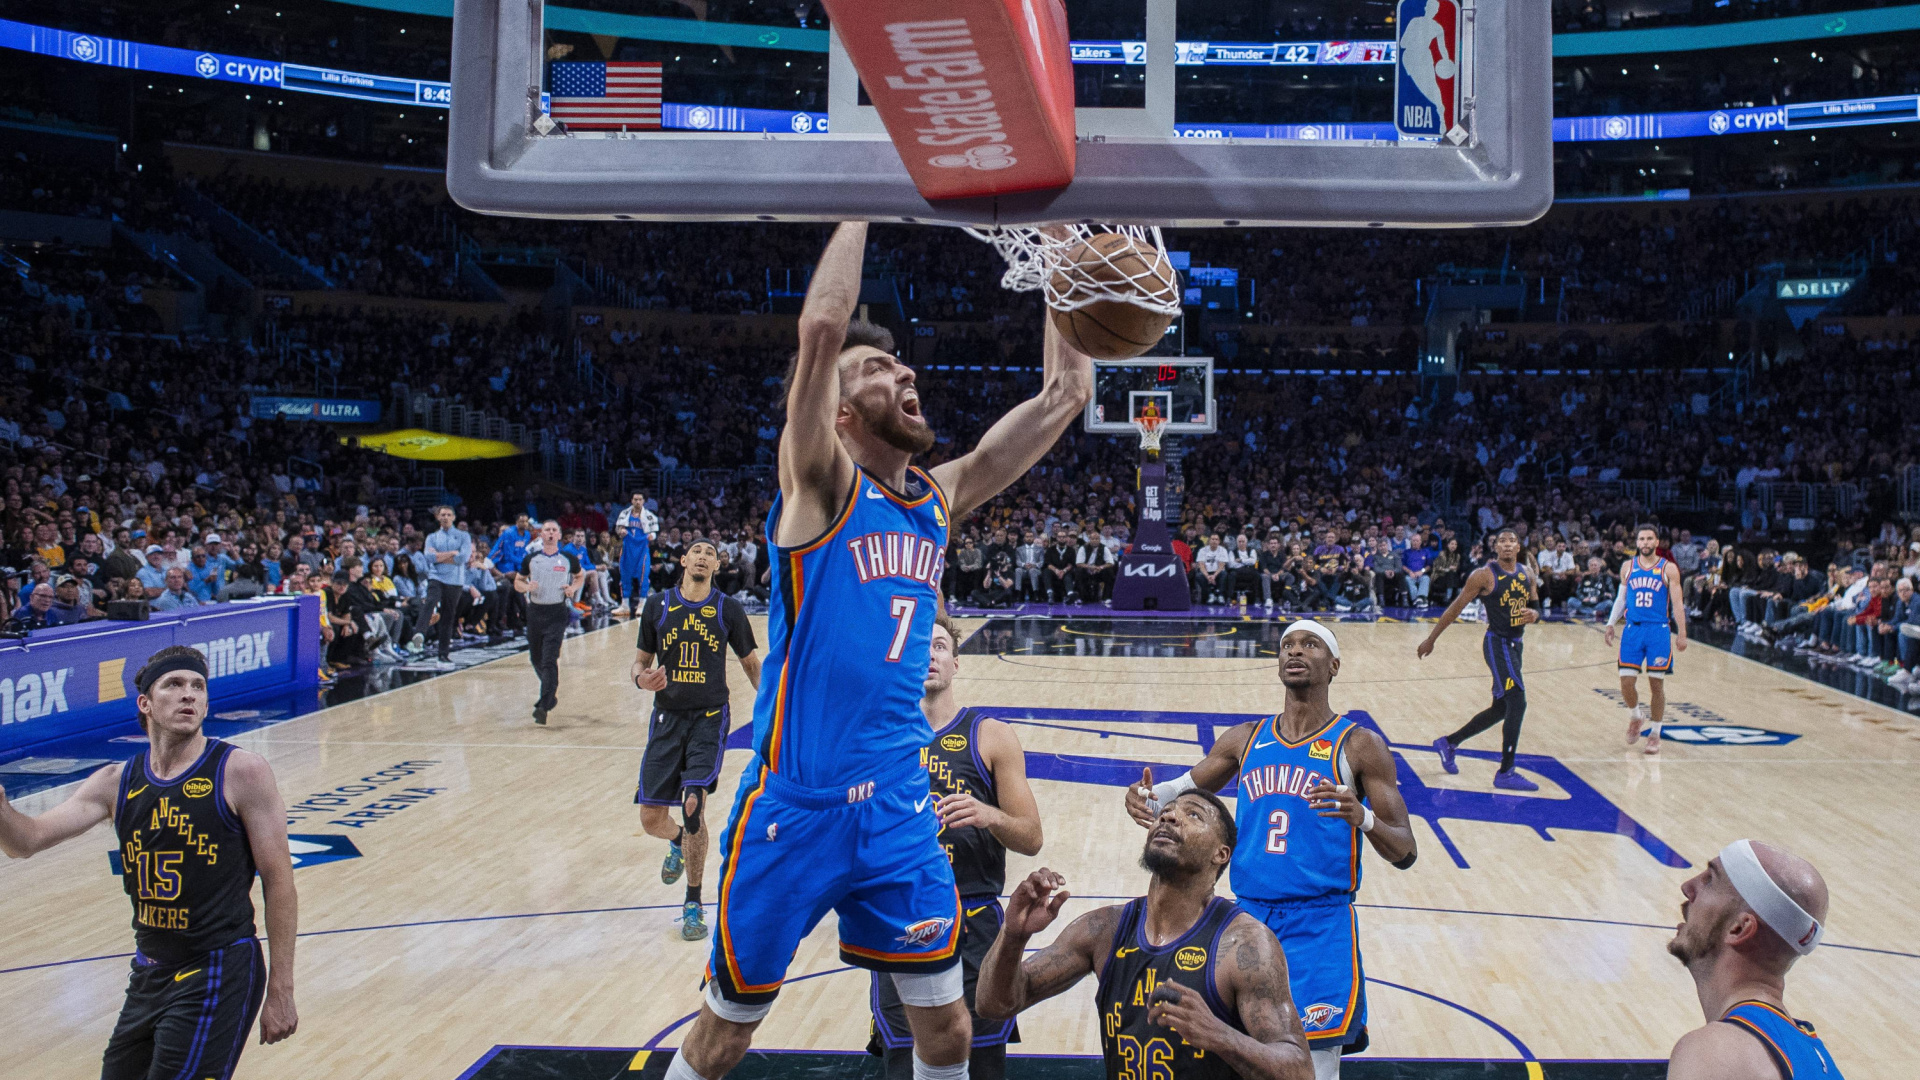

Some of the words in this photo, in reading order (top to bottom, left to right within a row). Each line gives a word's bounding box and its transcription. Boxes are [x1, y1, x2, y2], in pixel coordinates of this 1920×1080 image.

[1072, 48, 1111, 58] Lakers
[1215, 49, 1265, 60] Thunder
[1284, 46, 1309, 62] 42
[1403, 105, 1433, 128] NBA
[321, 404, 360, 416] ULTRA
[1145, 486, 1159, 497] GET
[1145, 497, 1159, 508] THE
[1141, 544, 1162, 552] Google
[847, 531, 945, 594] THUNDE
[1629, 577, 1663, 592] THUNDER
[1635, 591, 1653, 608] 25
[662, 627, 678, 650] LOS
[682, 613, 720, 652] ANGELES
[885, 595, 917, 662] 7
[678, 641, 699, 668] 11
[672, 669, 706, 683] LAKERS
[185, 782, 211, 792] bibigo
[847, 781, 875, 803] OKC
[326, 787, 448, 828] ARENA
[121, 829, 142, 873] LOS
[150, 797, 218, 865] ANGELES
[1265, 809, 1290, 855] 2
[136, 851, 184, 901] 15
[138, 902, 189, 930] LAKERS
[909, 922, 938, 944] OKC
[1178, 951, 1205, 964] bibigo
[1117, 1034, 1174, 1080] 36
